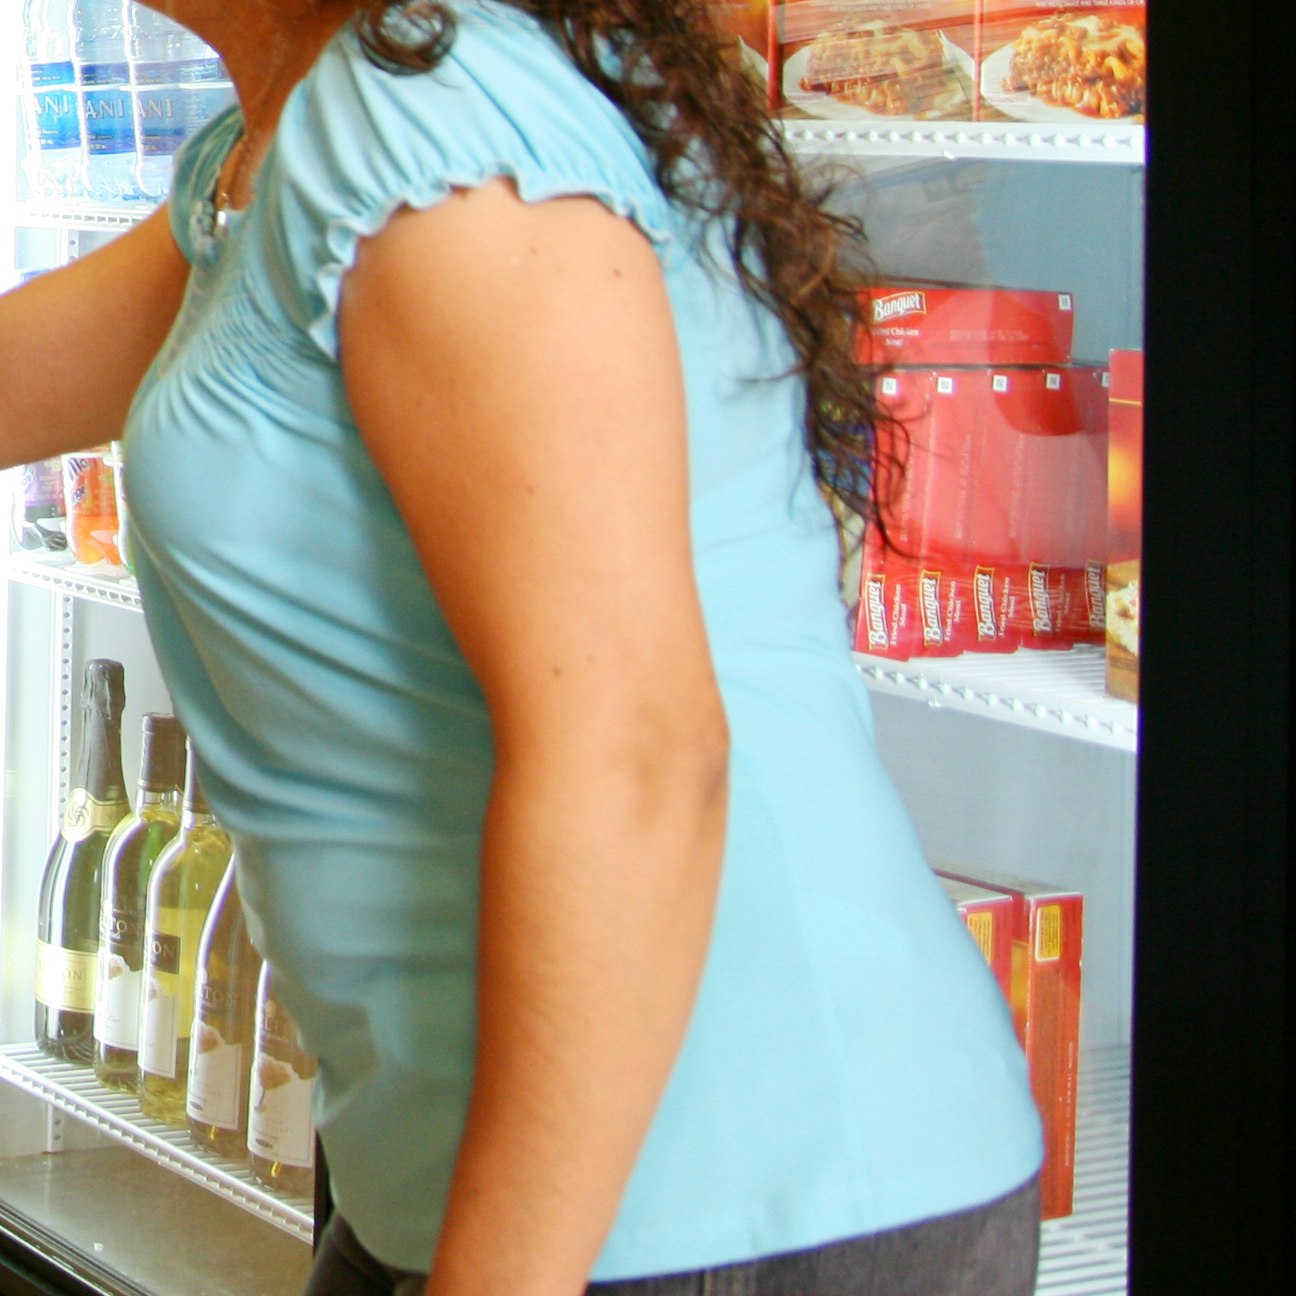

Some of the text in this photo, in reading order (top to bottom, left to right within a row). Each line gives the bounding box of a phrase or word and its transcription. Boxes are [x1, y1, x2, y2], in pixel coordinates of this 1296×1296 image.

[873, 292, 921, 322] Banquet
[867, 580, 888, 646] Banquet
[922, 577, 942, 641] Banquet
[977, 572, 996, 637] Banquet
[1031, 569, 1052, 633] Banquet
